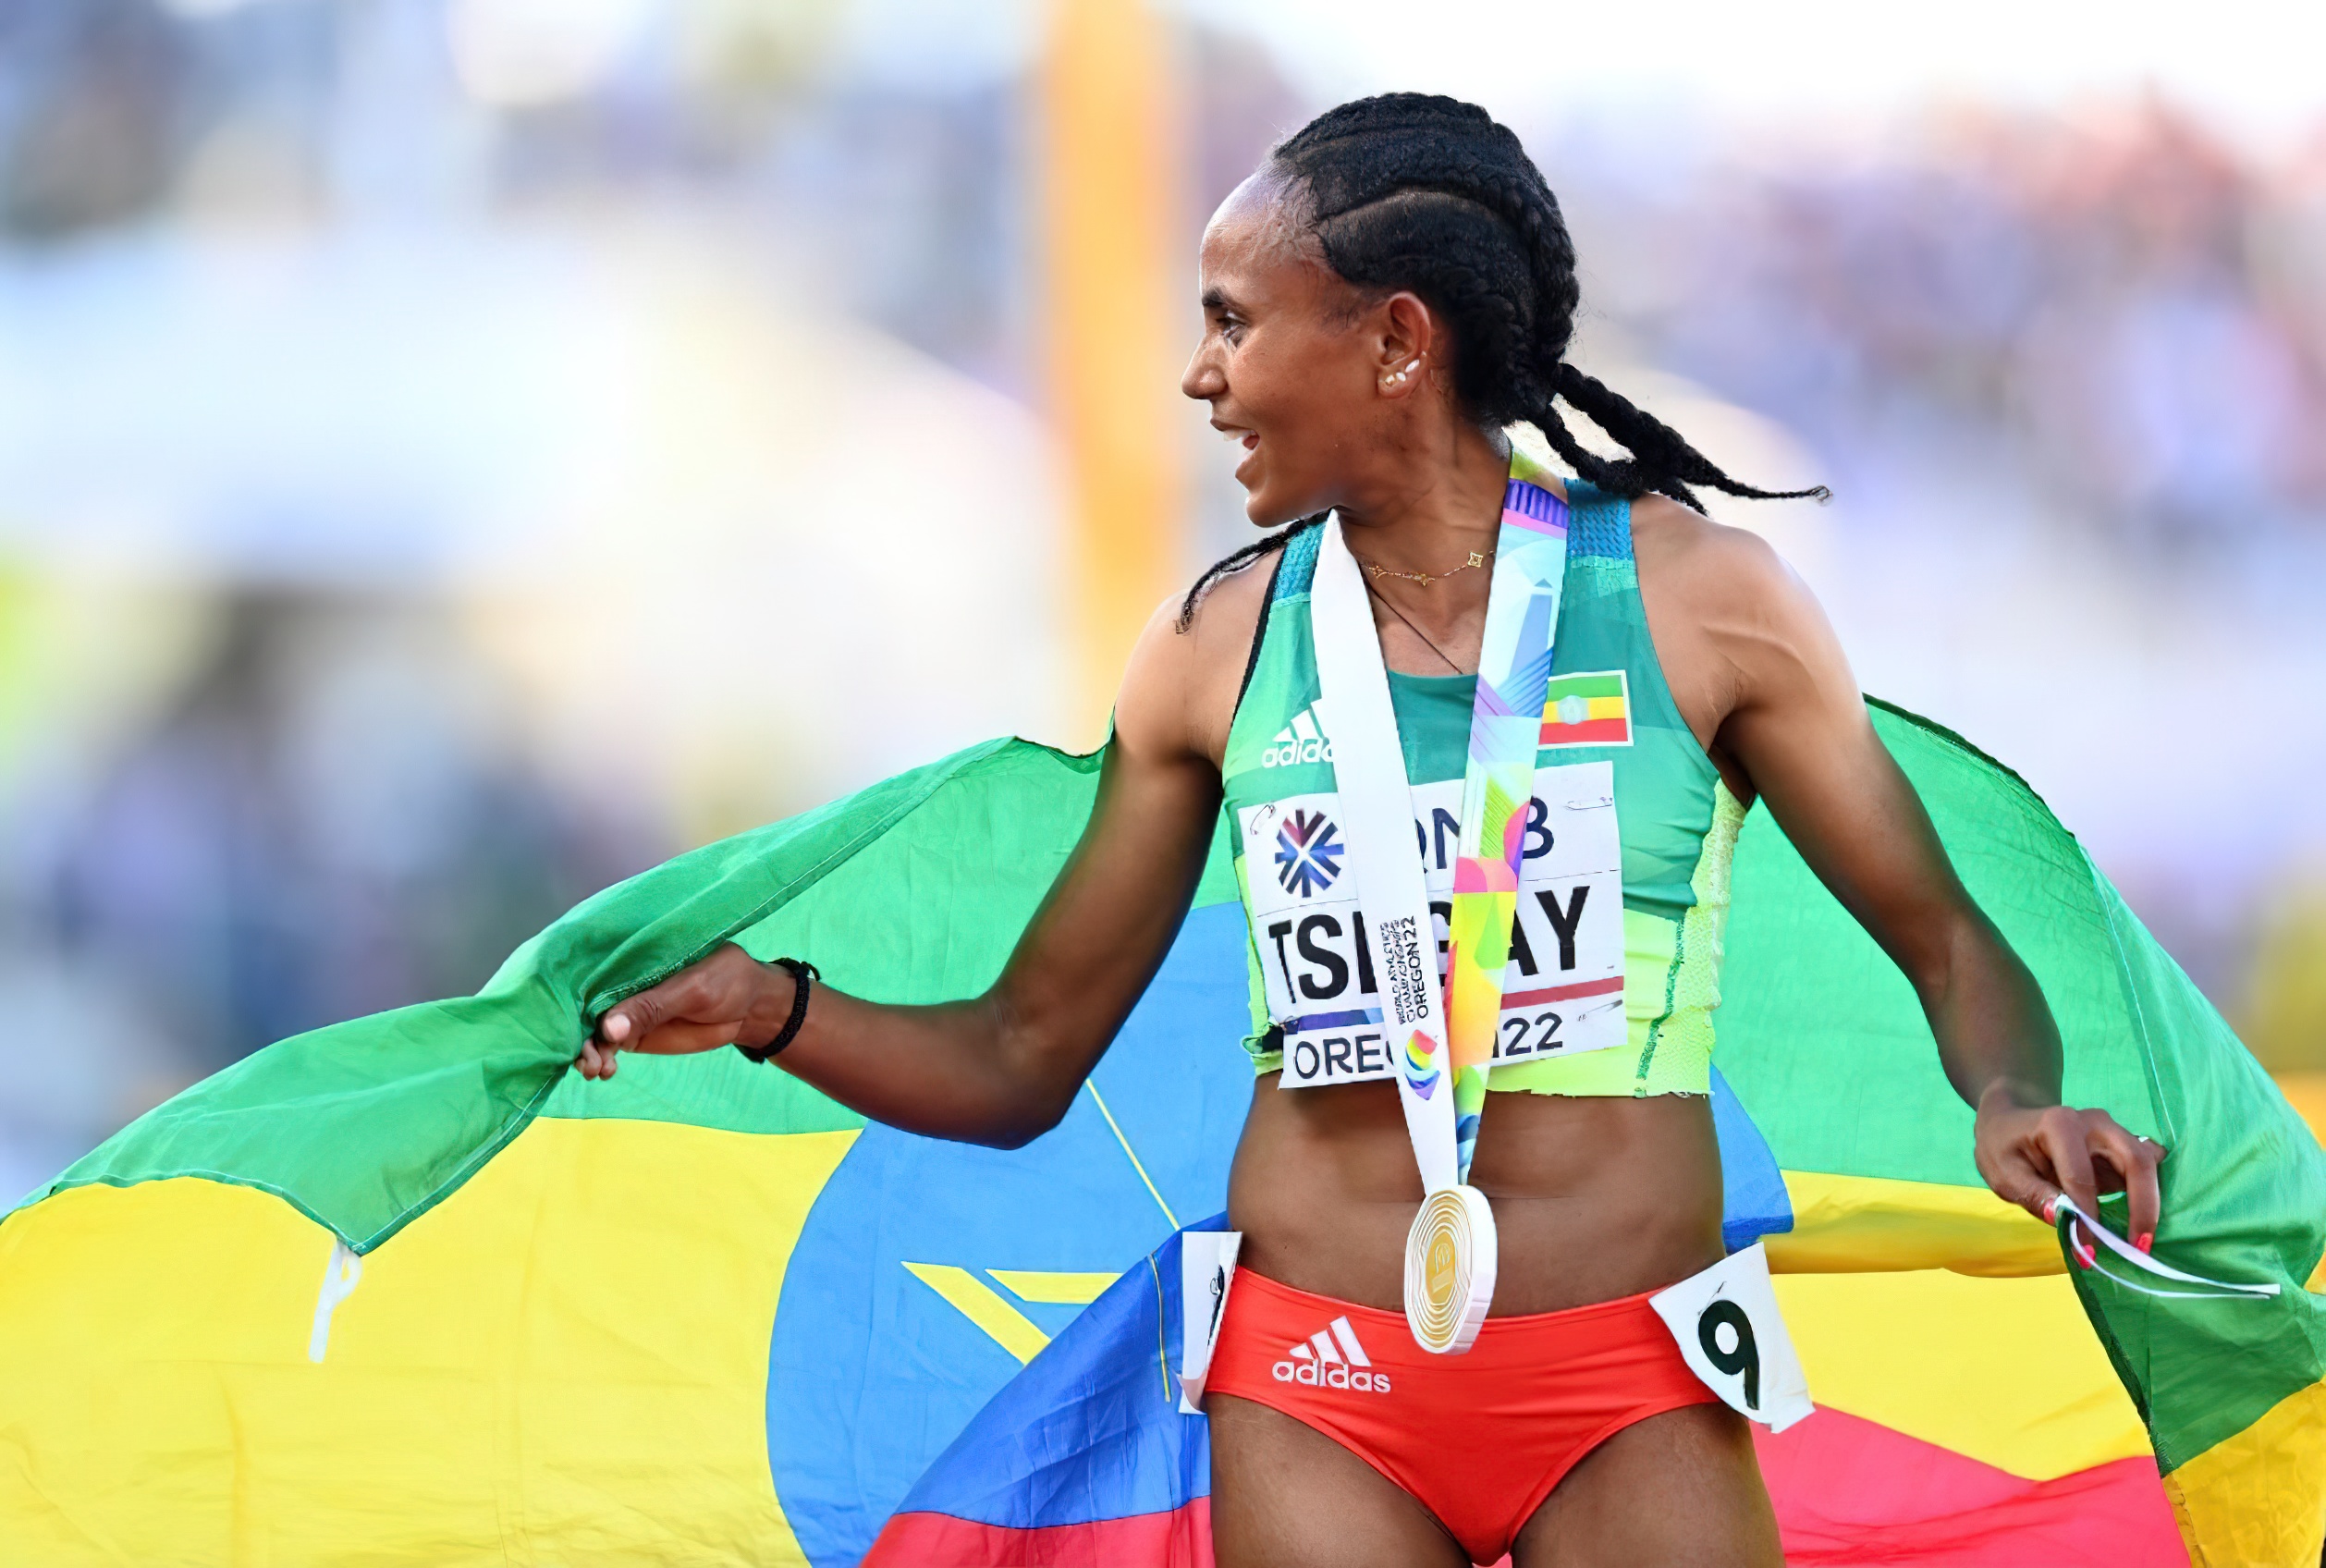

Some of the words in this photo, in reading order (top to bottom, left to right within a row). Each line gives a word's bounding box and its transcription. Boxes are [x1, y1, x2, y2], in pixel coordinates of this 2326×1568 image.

[1261, 739, 1333, 768] adida
[1267, 885, 1590, 1004] TSAY
[1271, 1358, 1391, 1393] adidas
[1697, 1299, 1760, 1411] 9
